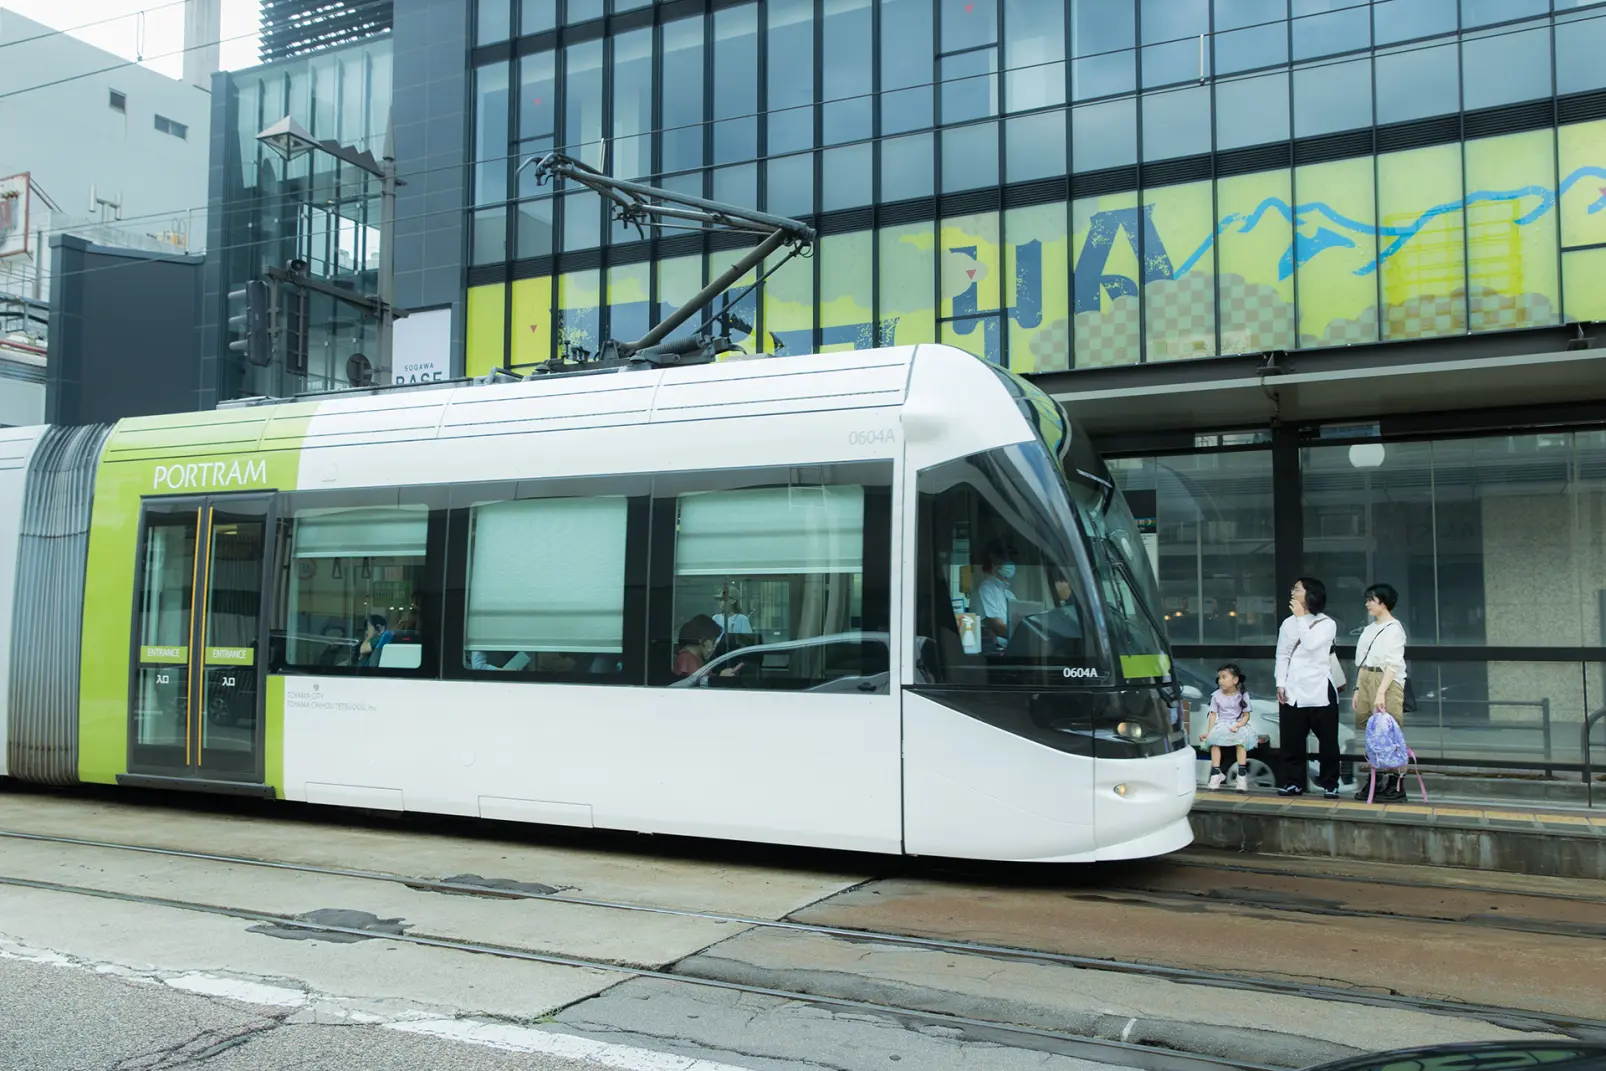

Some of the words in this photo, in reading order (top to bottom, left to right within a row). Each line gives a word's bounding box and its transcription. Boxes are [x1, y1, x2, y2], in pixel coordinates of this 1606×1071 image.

[404, 362, 434, 372] SOGAWA
[848, 428, 896, 446] 0604A
[153, 459, 267, 489] PORTRAM
[147, 647, 181, 658] ENTRANCE
[212, 648, 247, 659] ENTRANCE
[1062, 667, 1099, 678] 0604A
[156, 674, 169, 684] 入口
[222, 676, 235, 687] 入口
